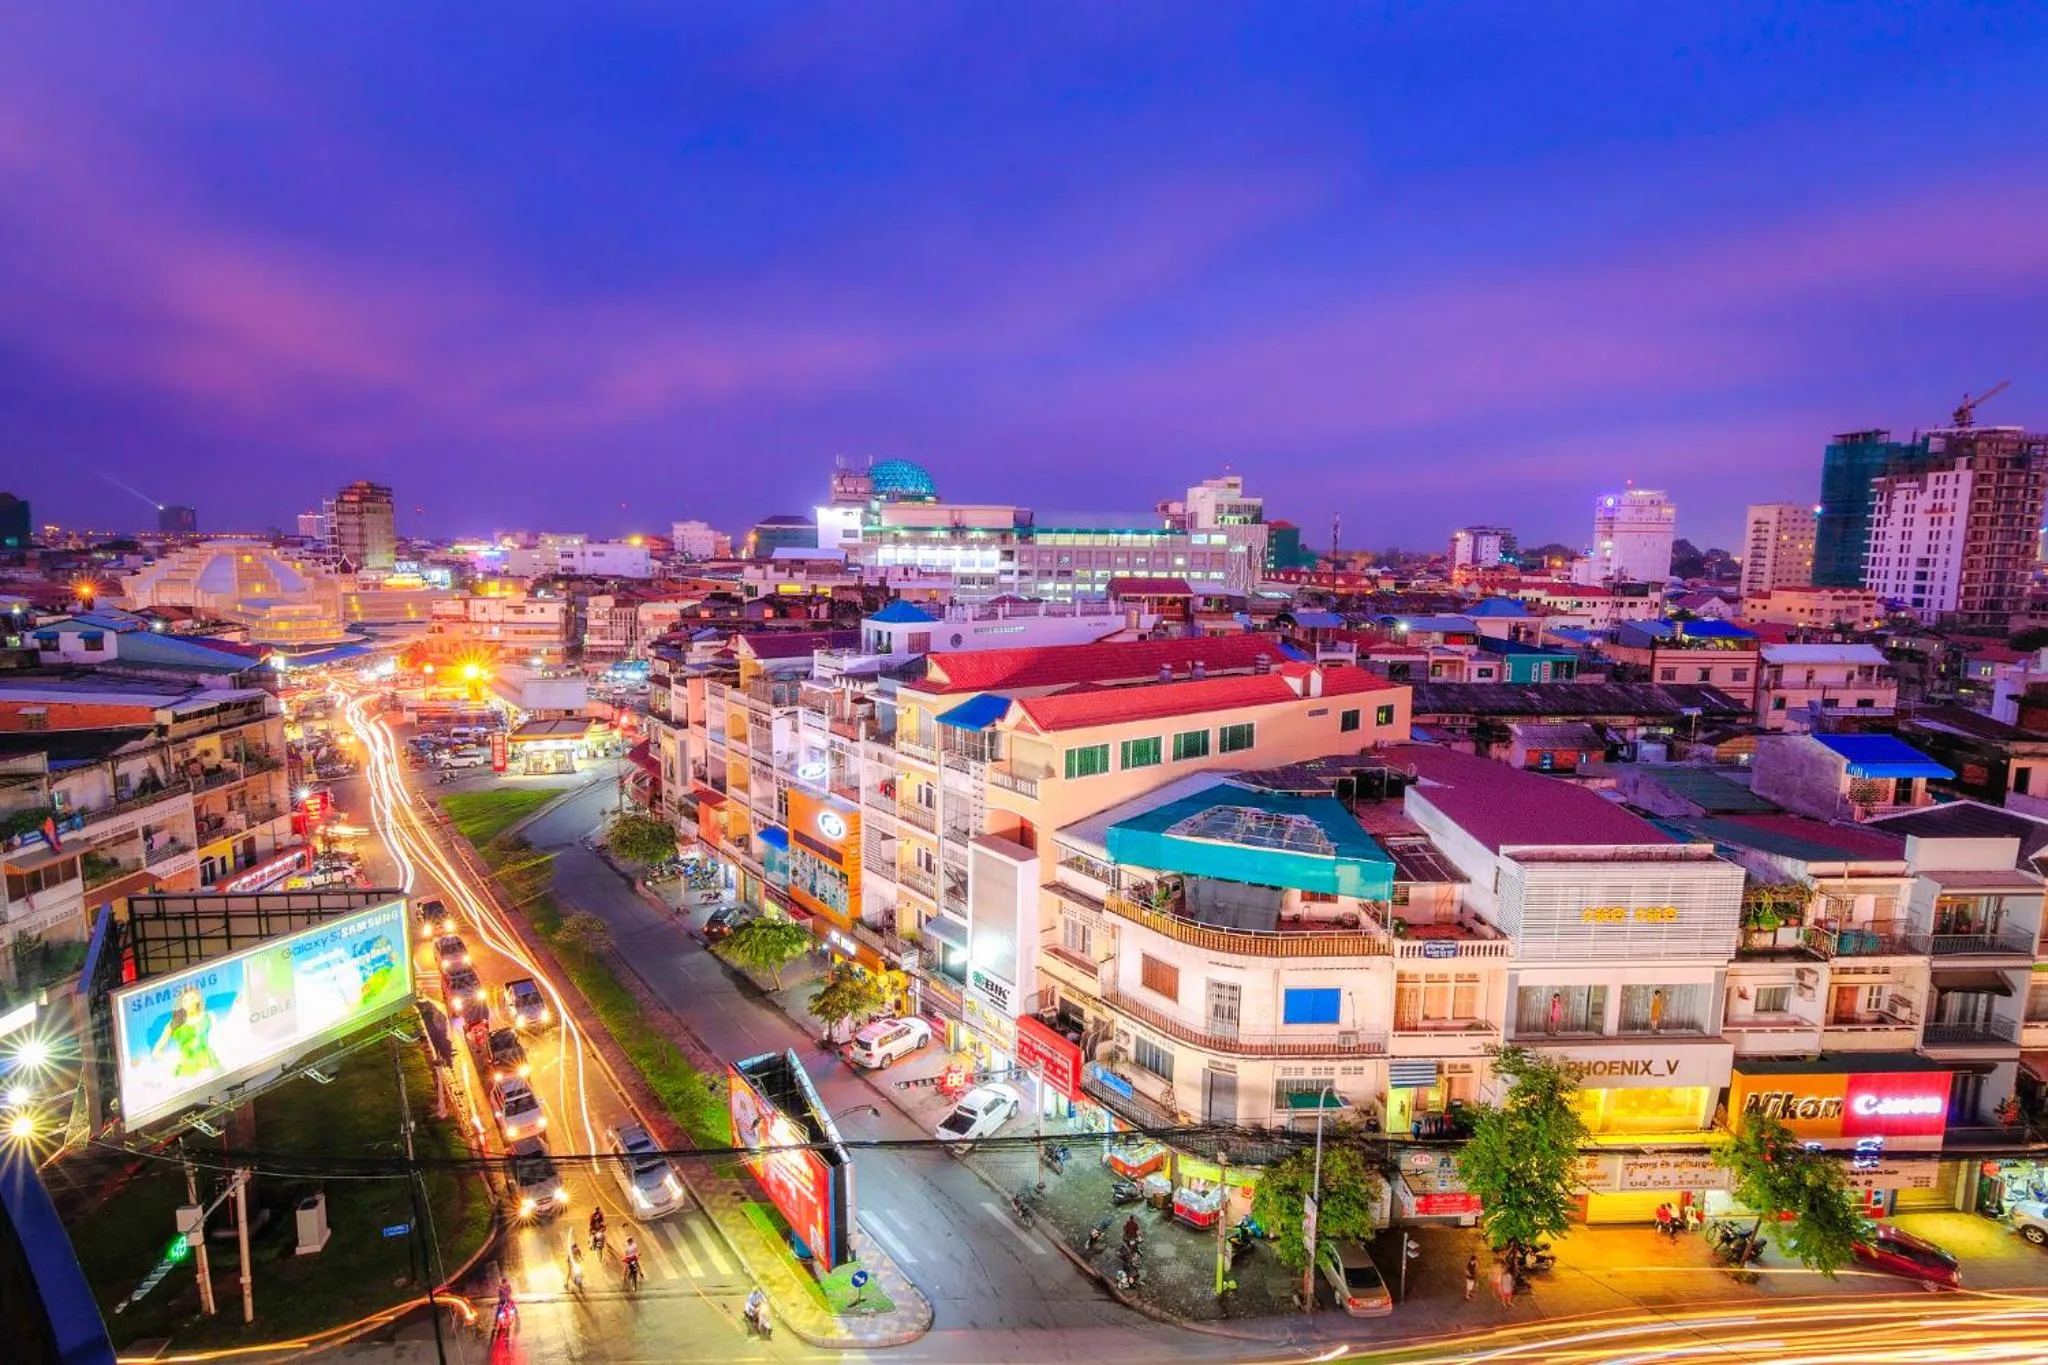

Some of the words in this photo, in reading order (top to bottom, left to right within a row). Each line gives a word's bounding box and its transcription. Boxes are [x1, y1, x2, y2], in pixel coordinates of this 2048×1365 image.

[340, 909, 399, 939] SAMSUNG
[281, 935, 328, 960] Galaxy
[131, 973, 218, 1013] SAMSUNG
[1743, 1091, 1844, 1121] Nikon
[1853, 1093, 1944, 1116] Canon
